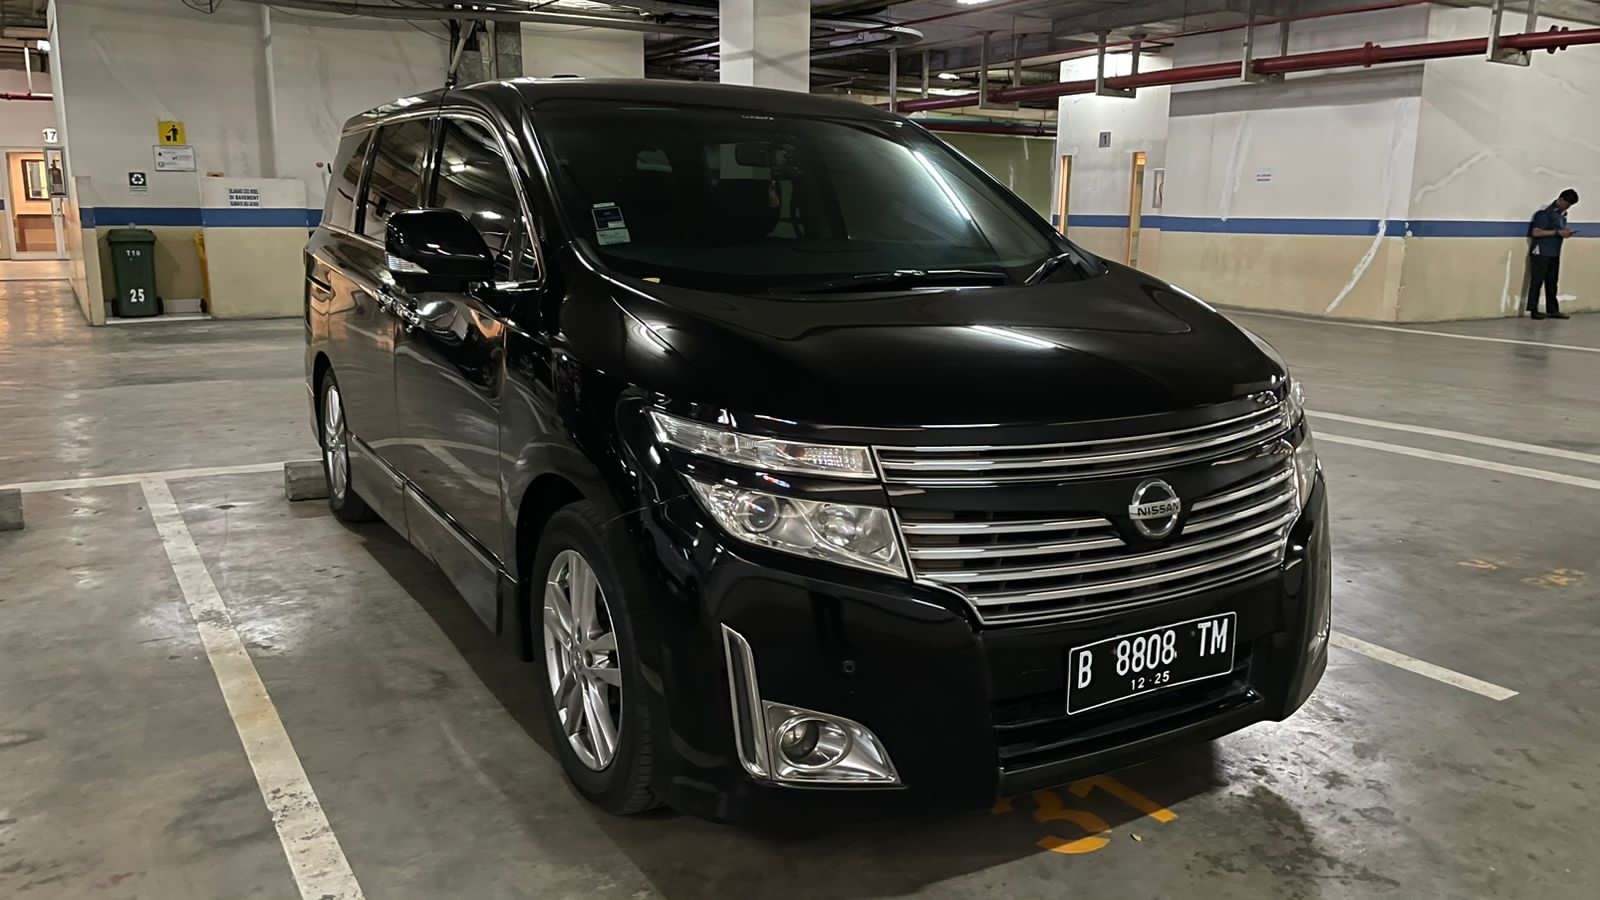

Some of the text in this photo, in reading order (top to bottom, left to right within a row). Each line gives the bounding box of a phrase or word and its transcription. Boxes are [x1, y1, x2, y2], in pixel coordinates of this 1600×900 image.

[43, 131, 57, 141] 17
[129, 288, 145, 303] 25
[1137, 502, 1179, 516] NISSAN
[1077, 617, 1229, 689] B 8808 TM
